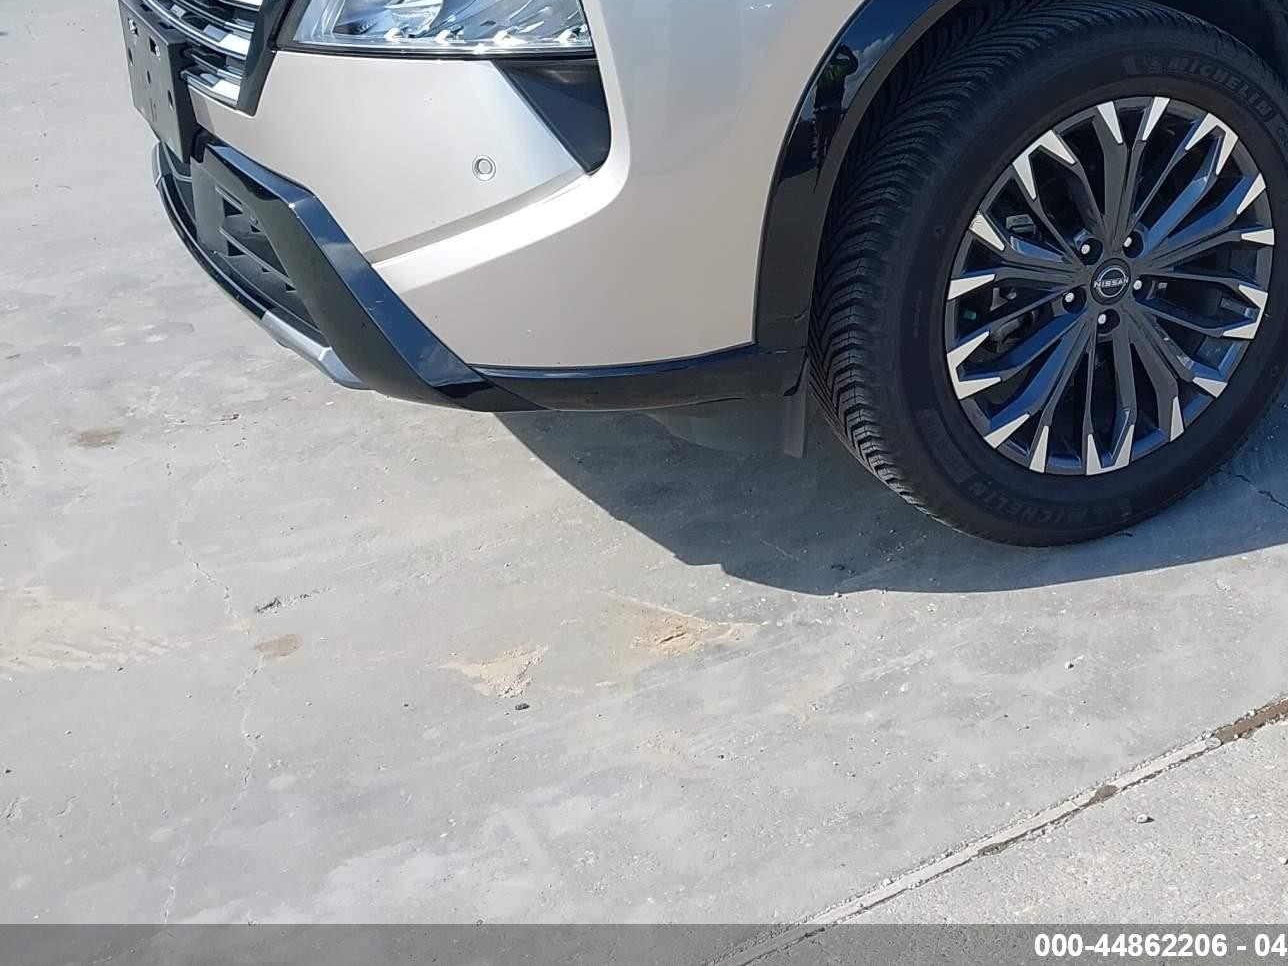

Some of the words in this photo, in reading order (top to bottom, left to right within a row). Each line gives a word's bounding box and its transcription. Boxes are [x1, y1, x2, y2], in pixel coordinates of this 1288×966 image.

[1166, 55, 1274, 118] MICHELIN
[1094, 276, 1129, 288] NISSAN
[968, 481, 1088, 524] MICHELIN
